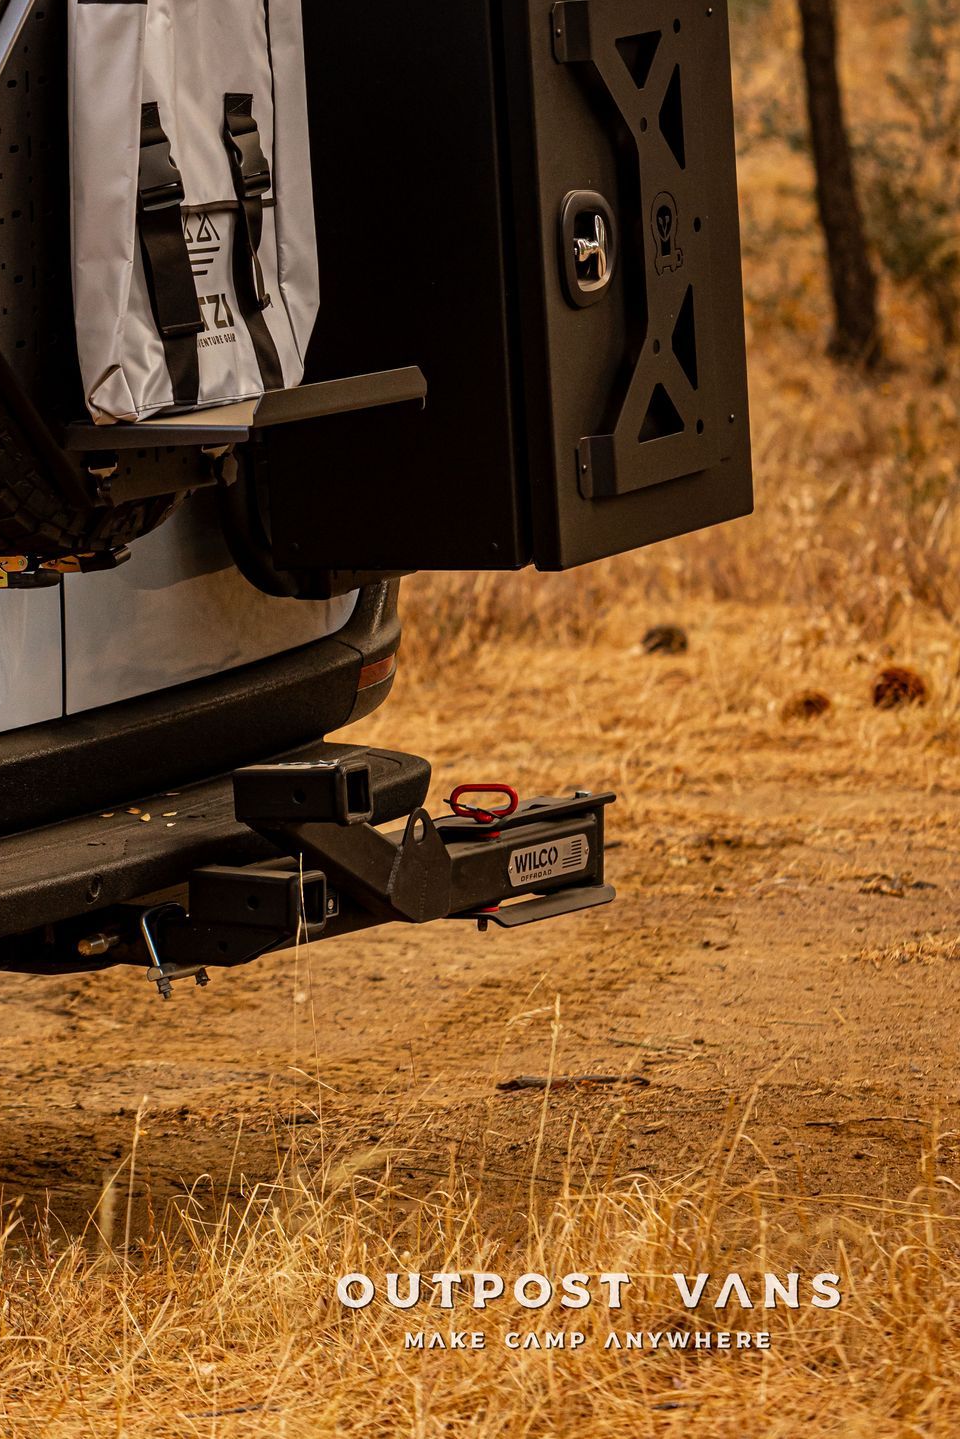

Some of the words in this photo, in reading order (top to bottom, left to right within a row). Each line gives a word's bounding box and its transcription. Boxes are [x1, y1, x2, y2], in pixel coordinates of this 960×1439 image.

[198, 293, 235, 331] TZI
[514, 846, 559, 874] WILCO
[520, 869, 552, 881] OFFROAD
